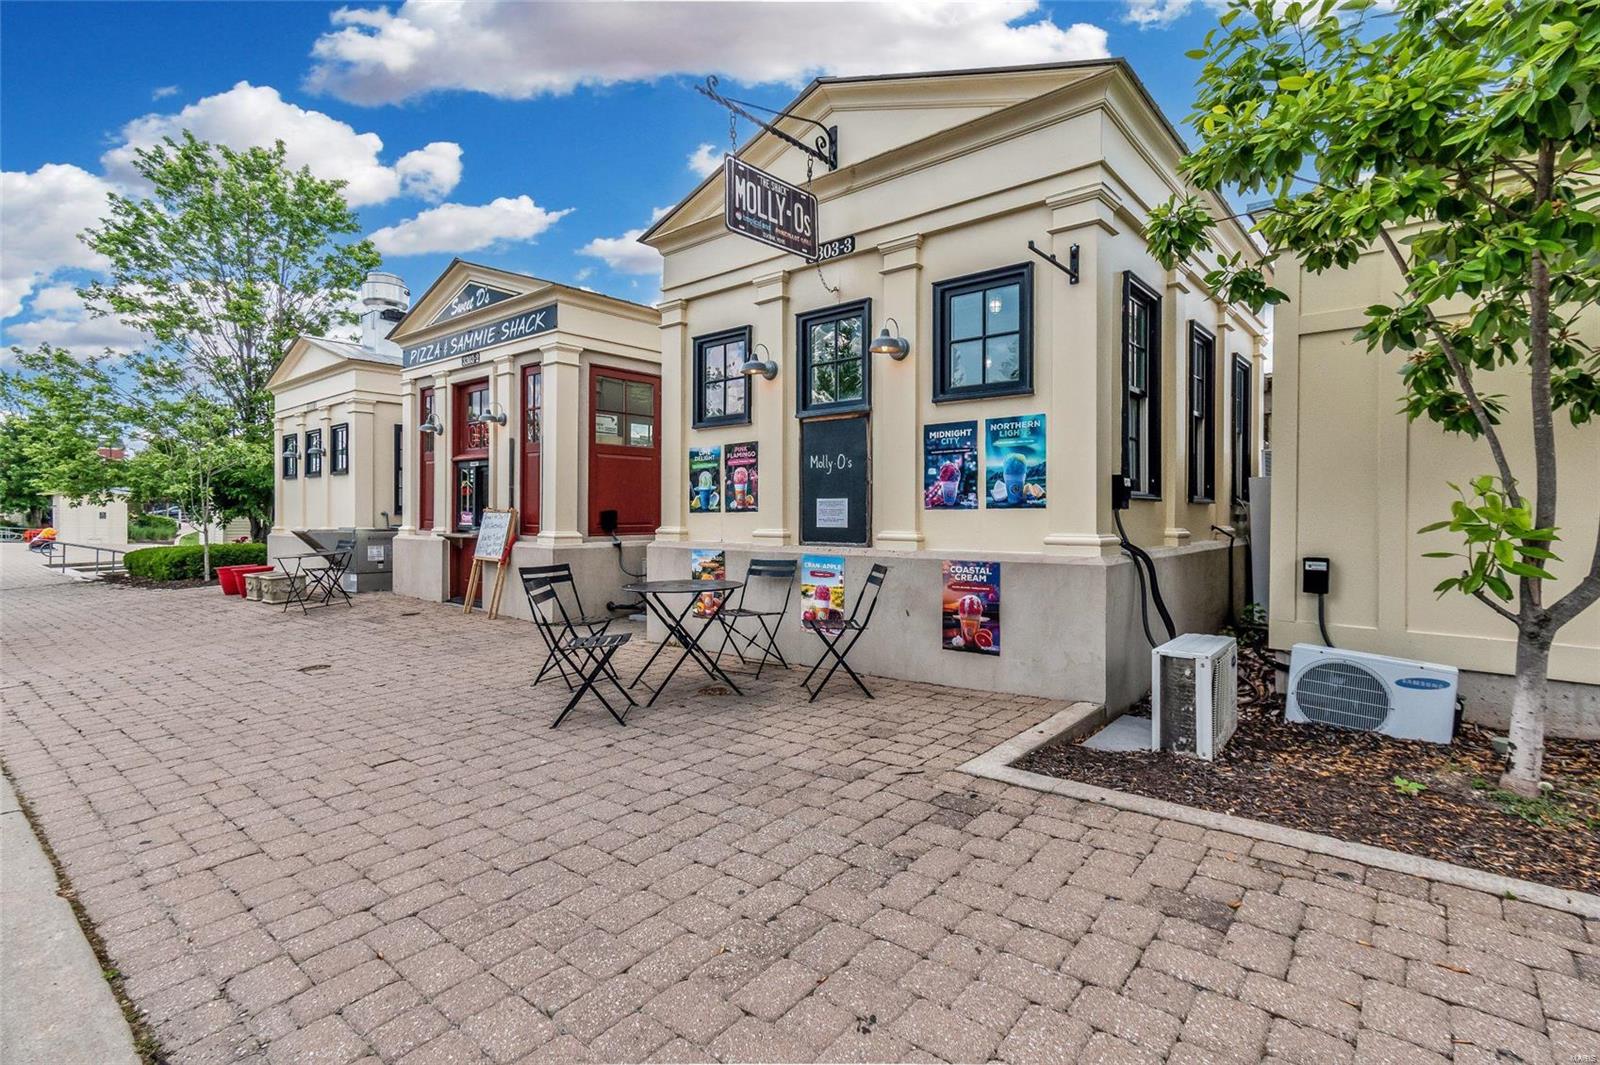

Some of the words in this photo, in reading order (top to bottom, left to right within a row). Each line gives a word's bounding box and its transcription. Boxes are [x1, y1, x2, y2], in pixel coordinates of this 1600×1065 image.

[450, 295, 474, 316] Sweet
[476, 287, 490, 307] D's
[409, 343, 441, 365] PIZZA
[450, 326, 497, 354] SAMMIE
[500, 310, 547, 341] SHACK
[990, 420, 1041, 431] NORTHERN
[929, 428, 973, 439] MIDNIGHT
[941, 437, 960, 445] CITY
[727, 450, 756, 459] FLAMINGO
[950, 565, 993, 575] COASTAL
[954, 573, 987, 583] CREAM
